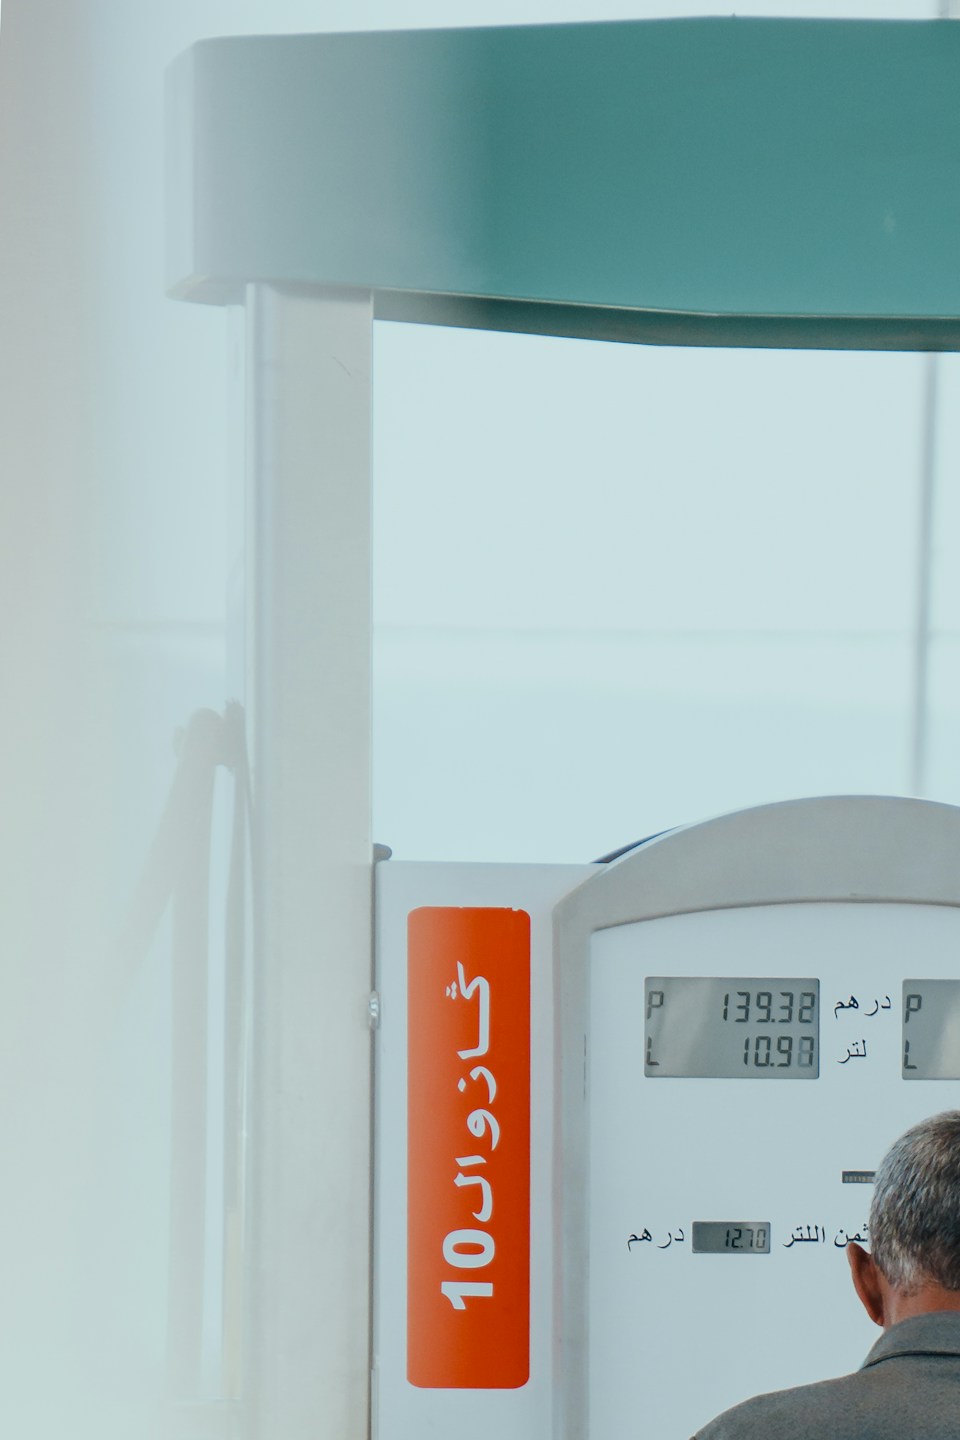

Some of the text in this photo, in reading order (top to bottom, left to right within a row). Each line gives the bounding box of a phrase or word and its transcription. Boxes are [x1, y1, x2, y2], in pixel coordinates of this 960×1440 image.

[647, 991, 815, 1023] P 139.32
[905, 994, 922, 1023] P
[647, 1036, 660, 1066] L
[836, 1039, 867, 1064] لتر
[904, 1039, 917, 1069] L
[724, 1228, 767, 1249] 12.70
[441, 1229, 495, 1310] 10
